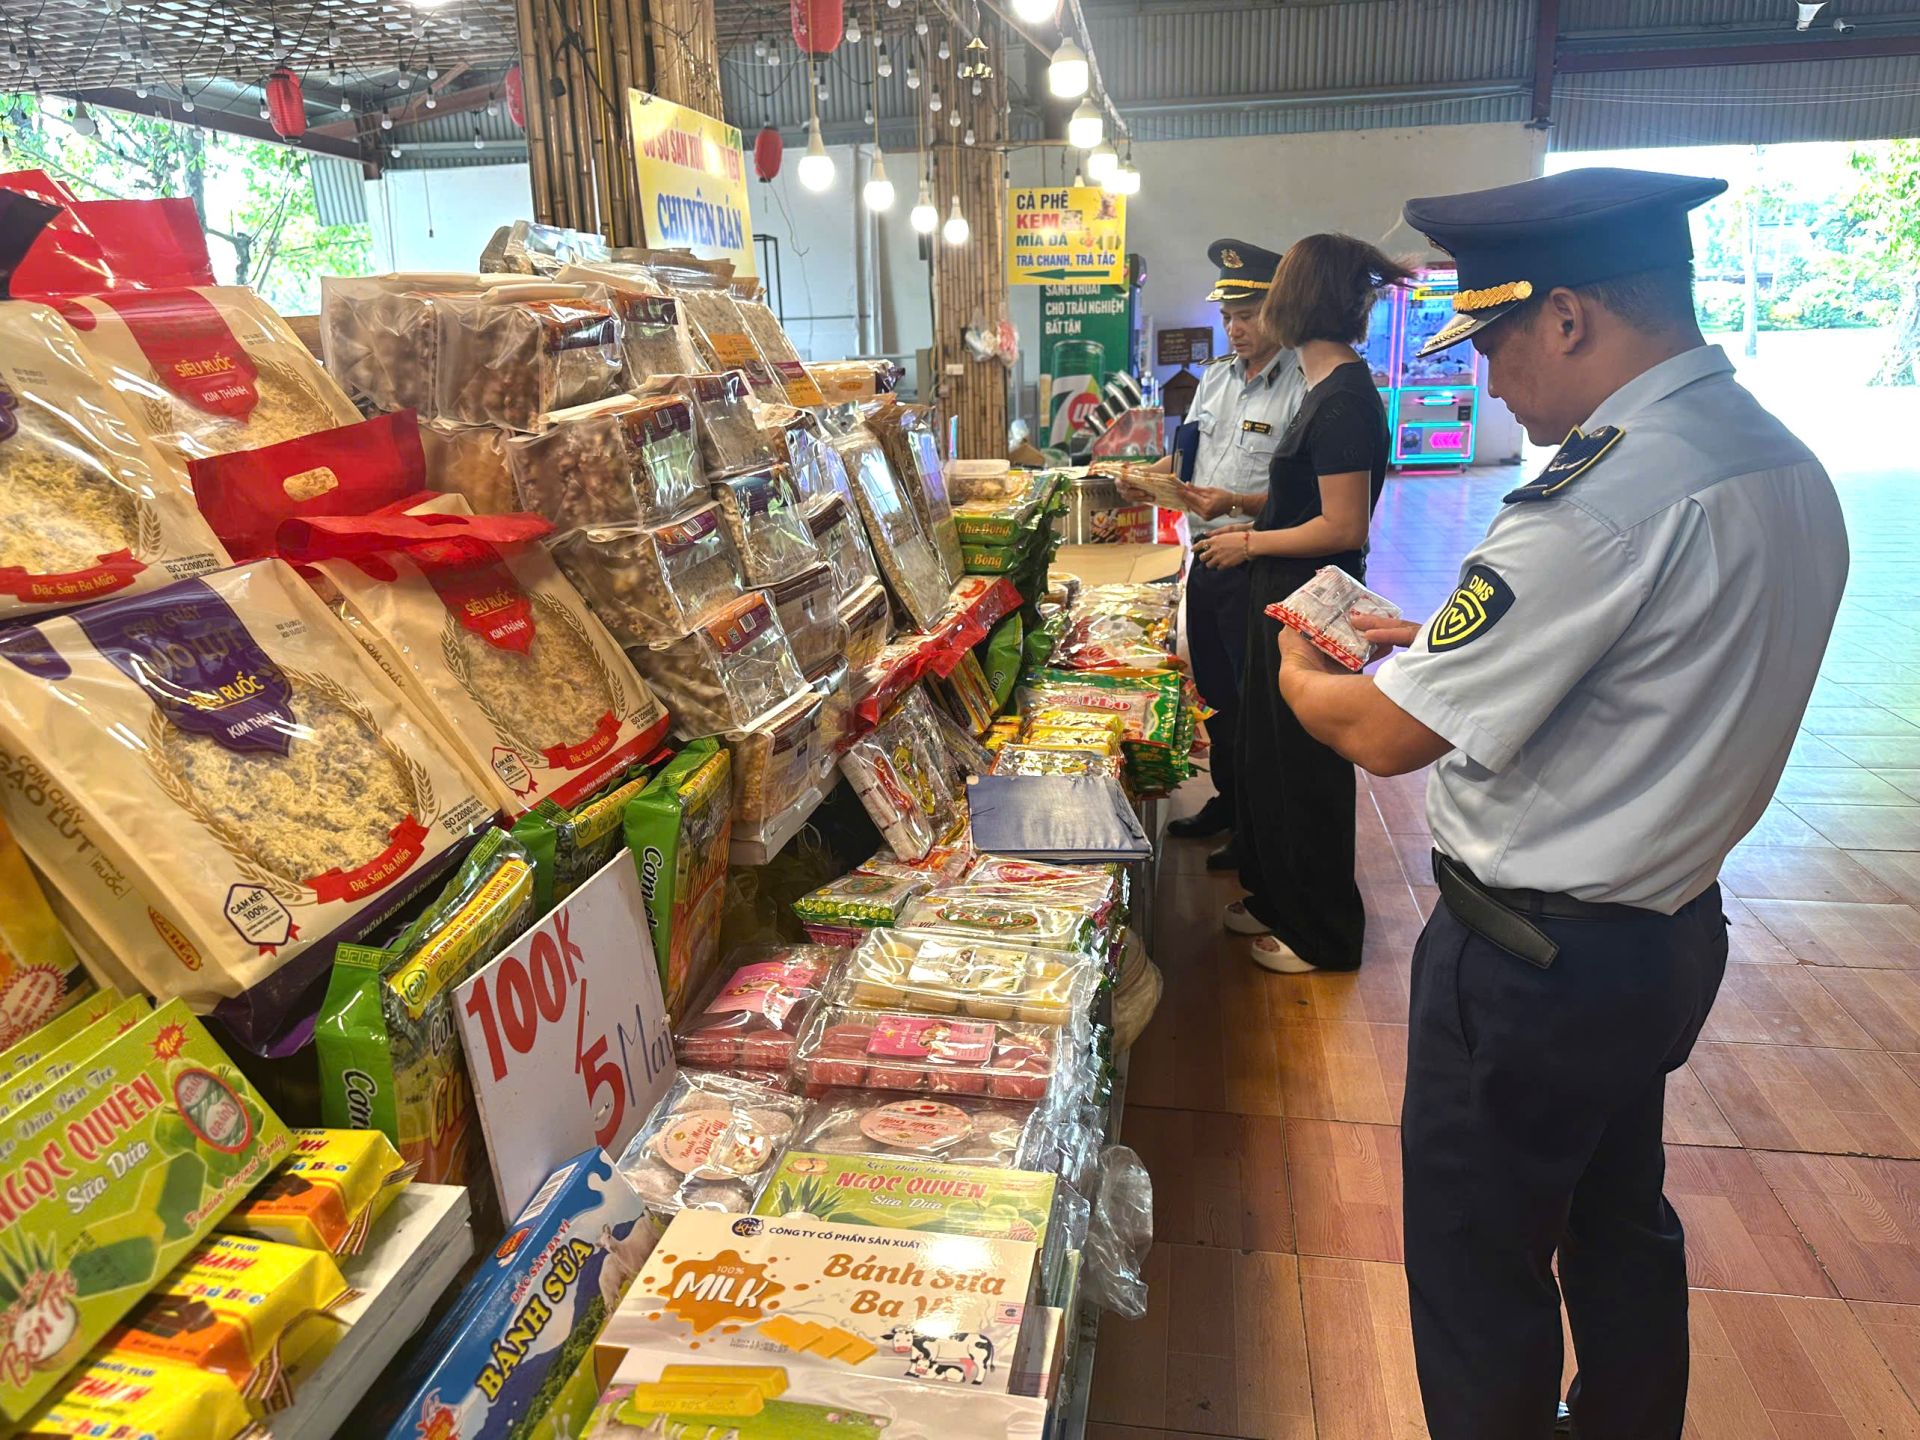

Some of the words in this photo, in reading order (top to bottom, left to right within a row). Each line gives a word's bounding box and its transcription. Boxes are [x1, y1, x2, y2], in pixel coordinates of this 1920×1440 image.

[1040, 190, 1069, 210] PHÊ
[657, 187, 716, 246] CHUYÊN
[1016, 213, 1060, 229] KEM
[1016, 253, 1034, 267] TRÀ
[1037, 255, 1073, 266] CHANH,
[1076, 253, 1093, 266] TRÀ
[1045, 302, 1065, 315] CHO
[1088, 298, 1125, 316] NGHIỆM
[1045, 317, 1062, 335] BẤT
[1064, 318, 1081, 336] TẬN
[174, 358, 204, 378] SIÊU
[203, 352, 236, 373] RUỐC
[202, 391, 220, 403] KIM
[218, 385, 249, 399] THÀNH
[32, 583, 54, 598] Đặc
[56, 580, 78, 594] Sản
[78, 579, 94, 593] Ba
[1468, 575, 1495, 601] DMS
[489, 627, 506, 640] KIM
[218, 670, 265, 701] RUỐC
[226, 721, 250, 739] KIM
[17, 754, 52, 787] CƠM
[48, 788, 85, 825] CHÁY
[442, 816, 457, 830] ISO
[350, 879, 369, 893] Đặc
[367, 869, 385, 886] Sản
[384, 861, 397, 875] Ba
[395, 847, 412, 869] Miền
[230, 897, 249, 915] CAM
[246, 889, 265, 906] KẾT
[243, 903, 268, 922] 100%
[66, 1071, 165, 1162] QUYÊN
[66, 1178, 109, 1214] Sữa
[835, 1172, 902, 1194] NGỌC
[905, 1175, 988, 1200] QUYÊN
[769, 1226, 800, 1237] CÔNG
[802, 1230, 815, 1238] TY
[868, 1235, 891, 1246] SẢN
[511, 1274, 533, 1305] ĐẶC
[528, 1252, 549, 1279] SẢN
[546, 1235, 562, 1254] BA
[717, 1265, 745, 1276] 100%
[823, 1254, 924, 1287] Bánh
[671, 1271, 771, 1311] MILK
[850, 1289, 905, 1319] Ba
[475, 1294, 552, 1404] BÁNH
[544, 1236, 597, 1305] SỮA
